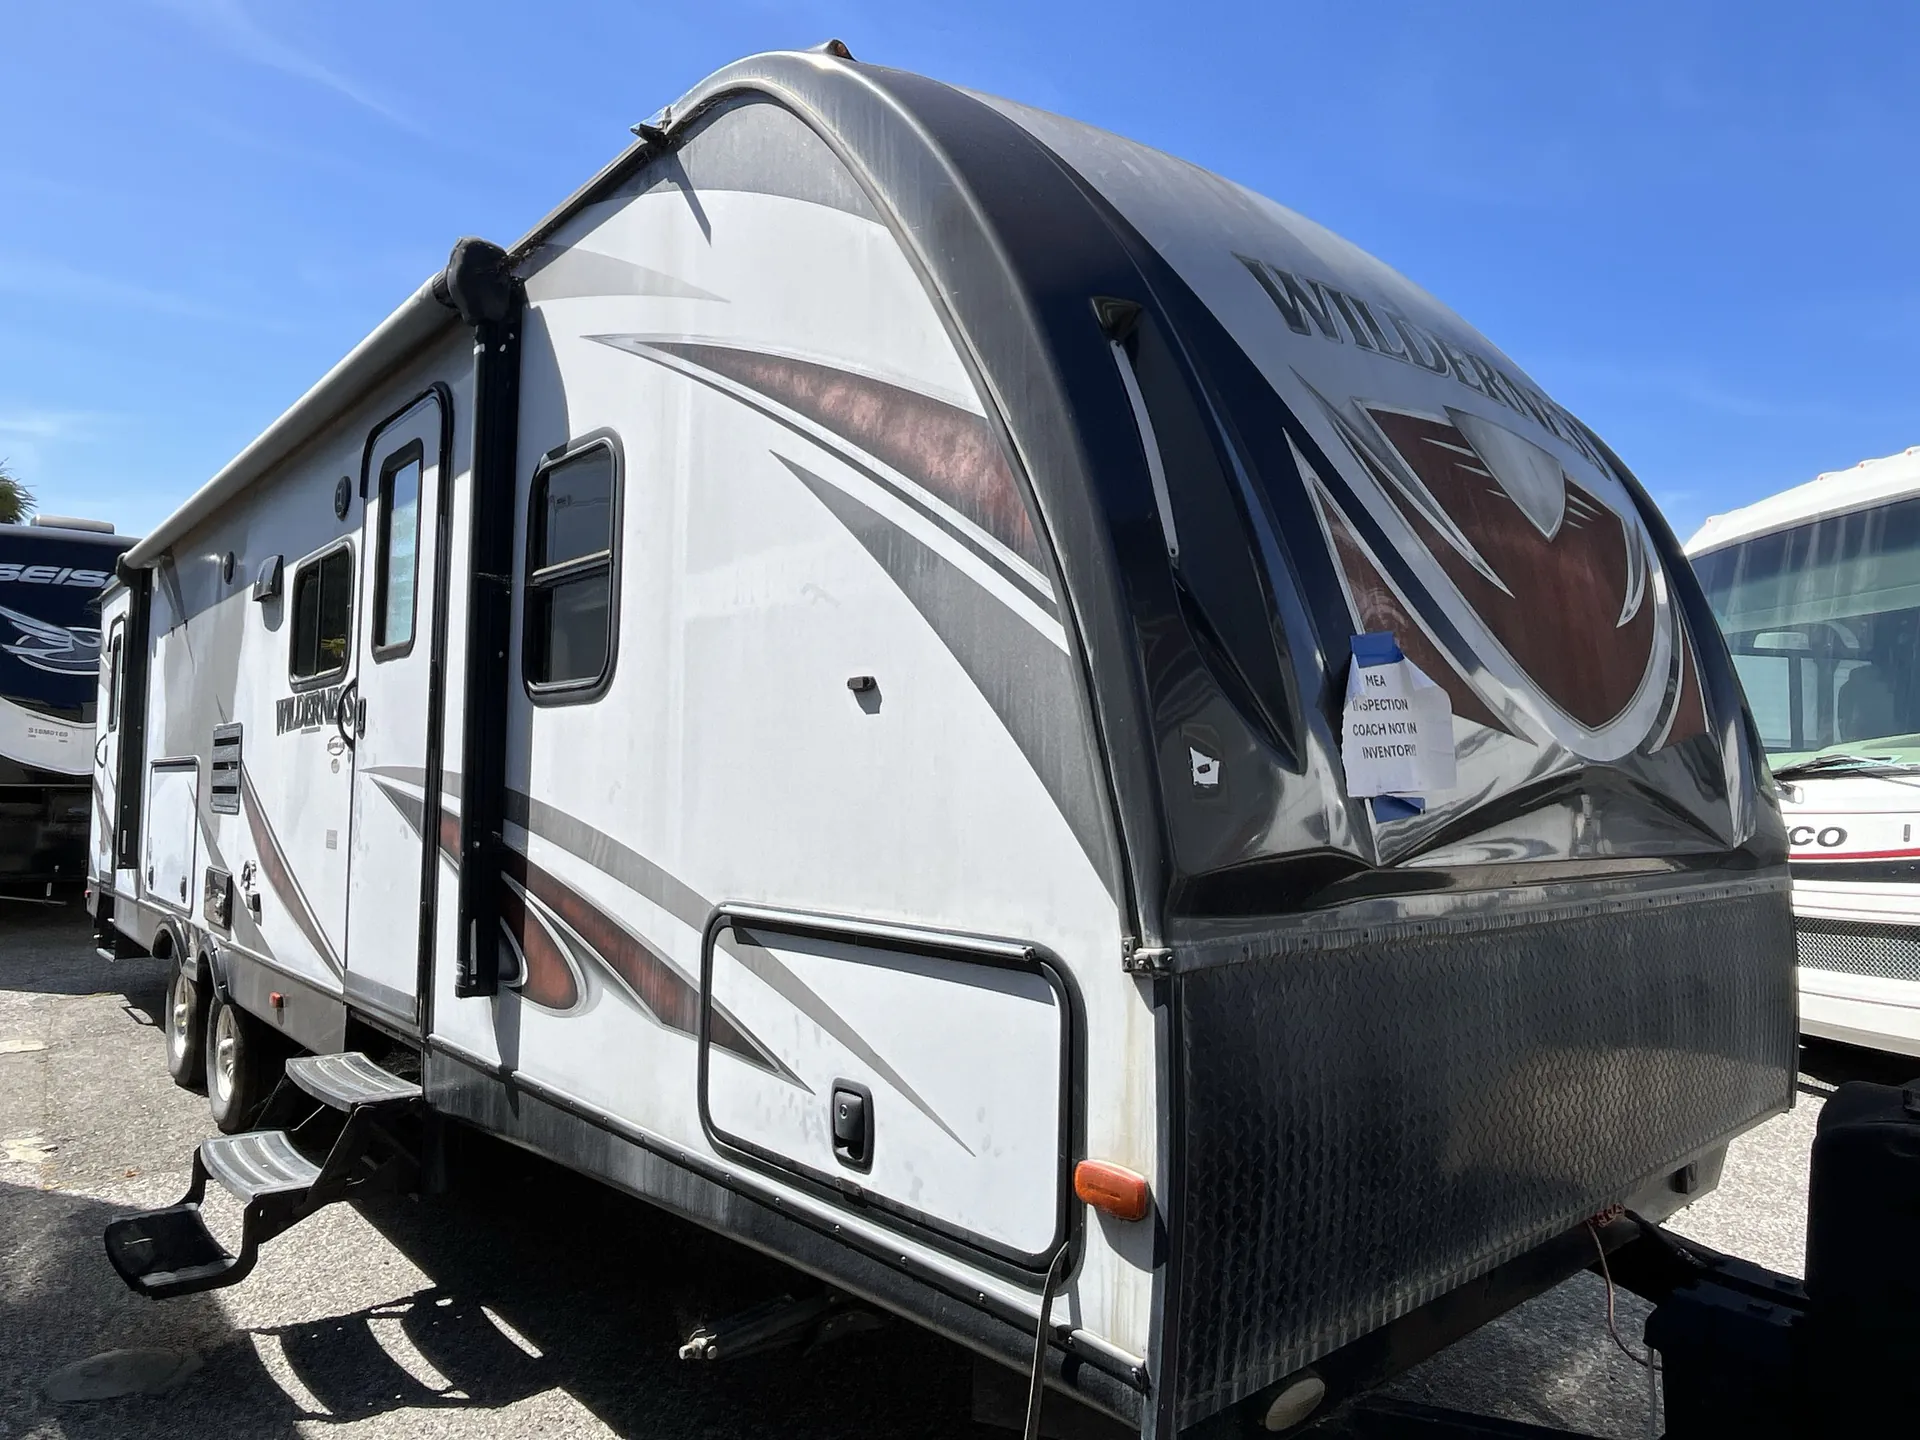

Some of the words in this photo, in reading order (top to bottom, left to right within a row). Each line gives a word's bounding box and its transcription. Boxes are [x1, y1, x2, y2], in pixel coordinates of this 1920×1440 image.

[1231, 251, 1612, 481] WILDERNESS
[1365, 674, 1387, 688] MEA
[1352, 723, 1387, 737] COACH
[1388, 722, 1406, 735] NOT
[1406, 721, 1418, 735] IN
[1784, 826, 1848, 847] CO
